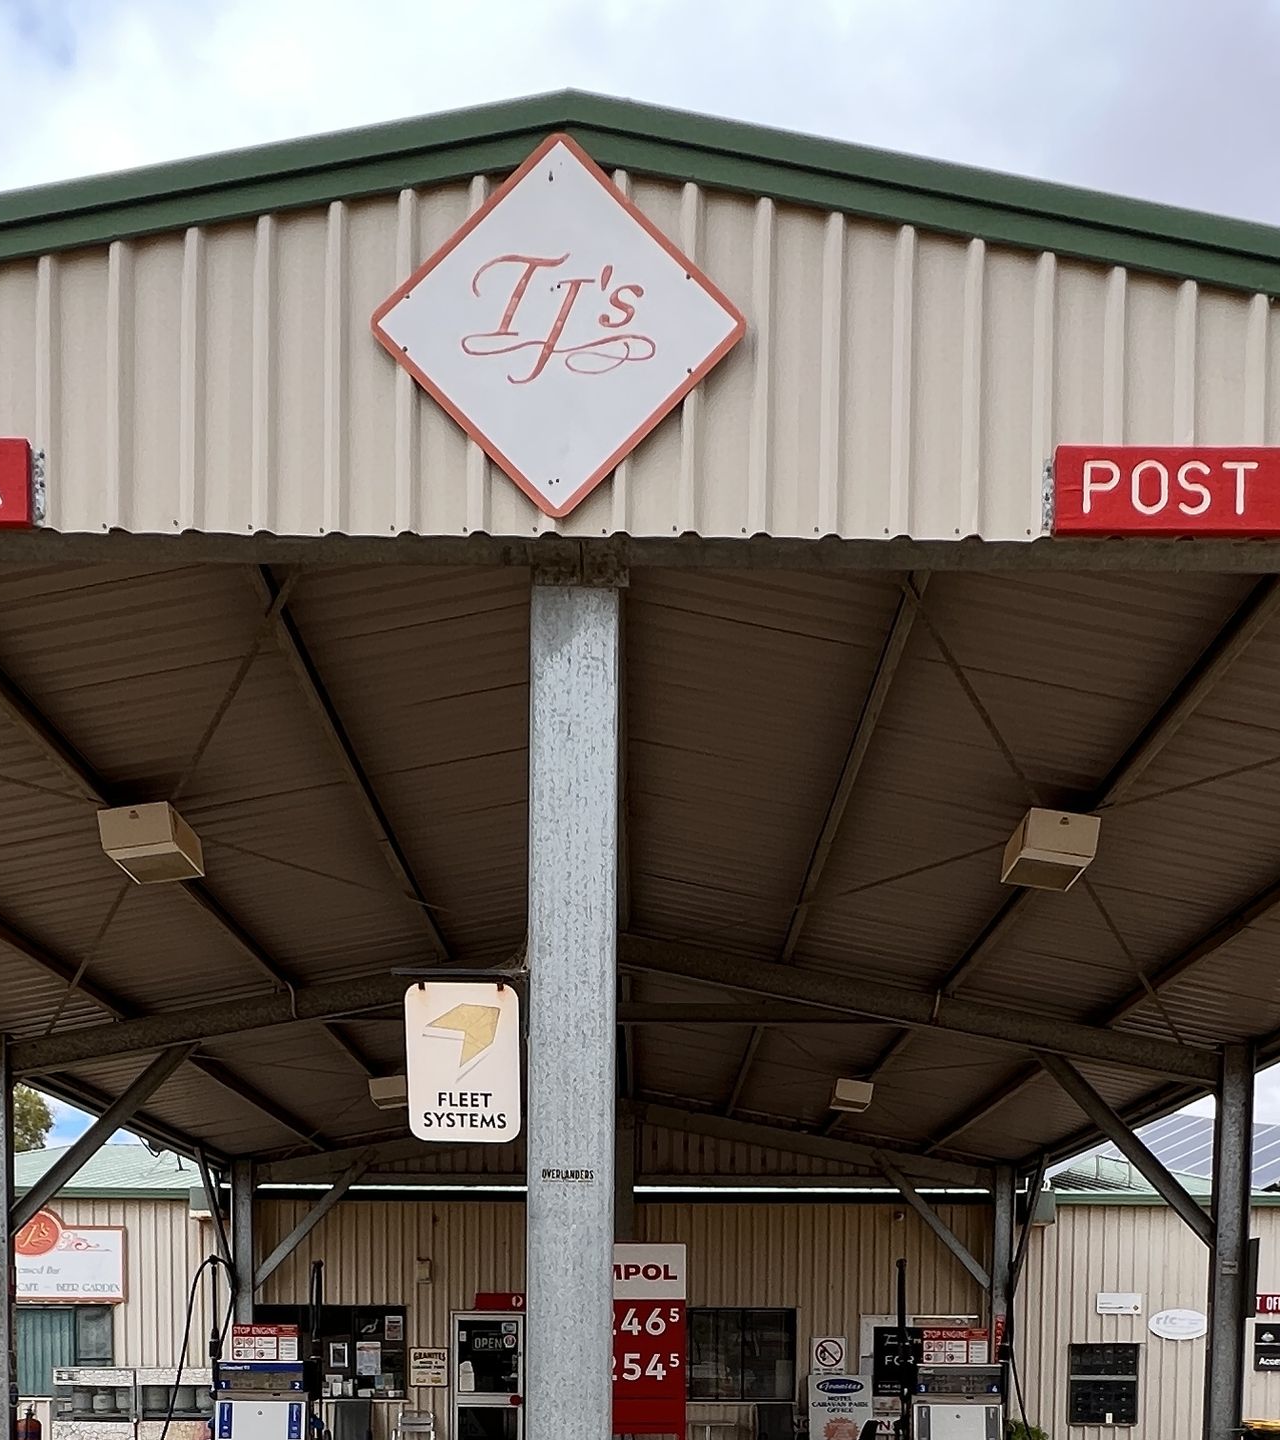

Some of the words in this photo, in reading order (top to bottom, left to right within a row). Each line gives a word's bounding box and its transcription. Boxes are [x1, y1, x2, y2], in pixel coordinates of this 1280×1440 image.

[462, 253, 656, 384] TJ's
[1080, 460, 1260, 517] POST
[437, 1092, 493, 1108] FLEET
[423, 1112, 508, 1129] SYSTEMS
[541, 1168, 594, 1180] OVERLANDERS
[56, 1283, 79, 1292] BEER
[81, 1283, 121, 1292] GARDEN
[233, 1326, 251, 1335] STOP
[251, 1326, 278, 1335] ENGINE
[923, 1330, 941, 1339] STOP
[942, 1330, 968, 1339] ENGINE
[474, 1337, 503, 1349] OPEN
[221, 1381, 226, 1389] 1
[294, 1381, 301, 1389] 2
[920, 1384, 926, 1392] 3
